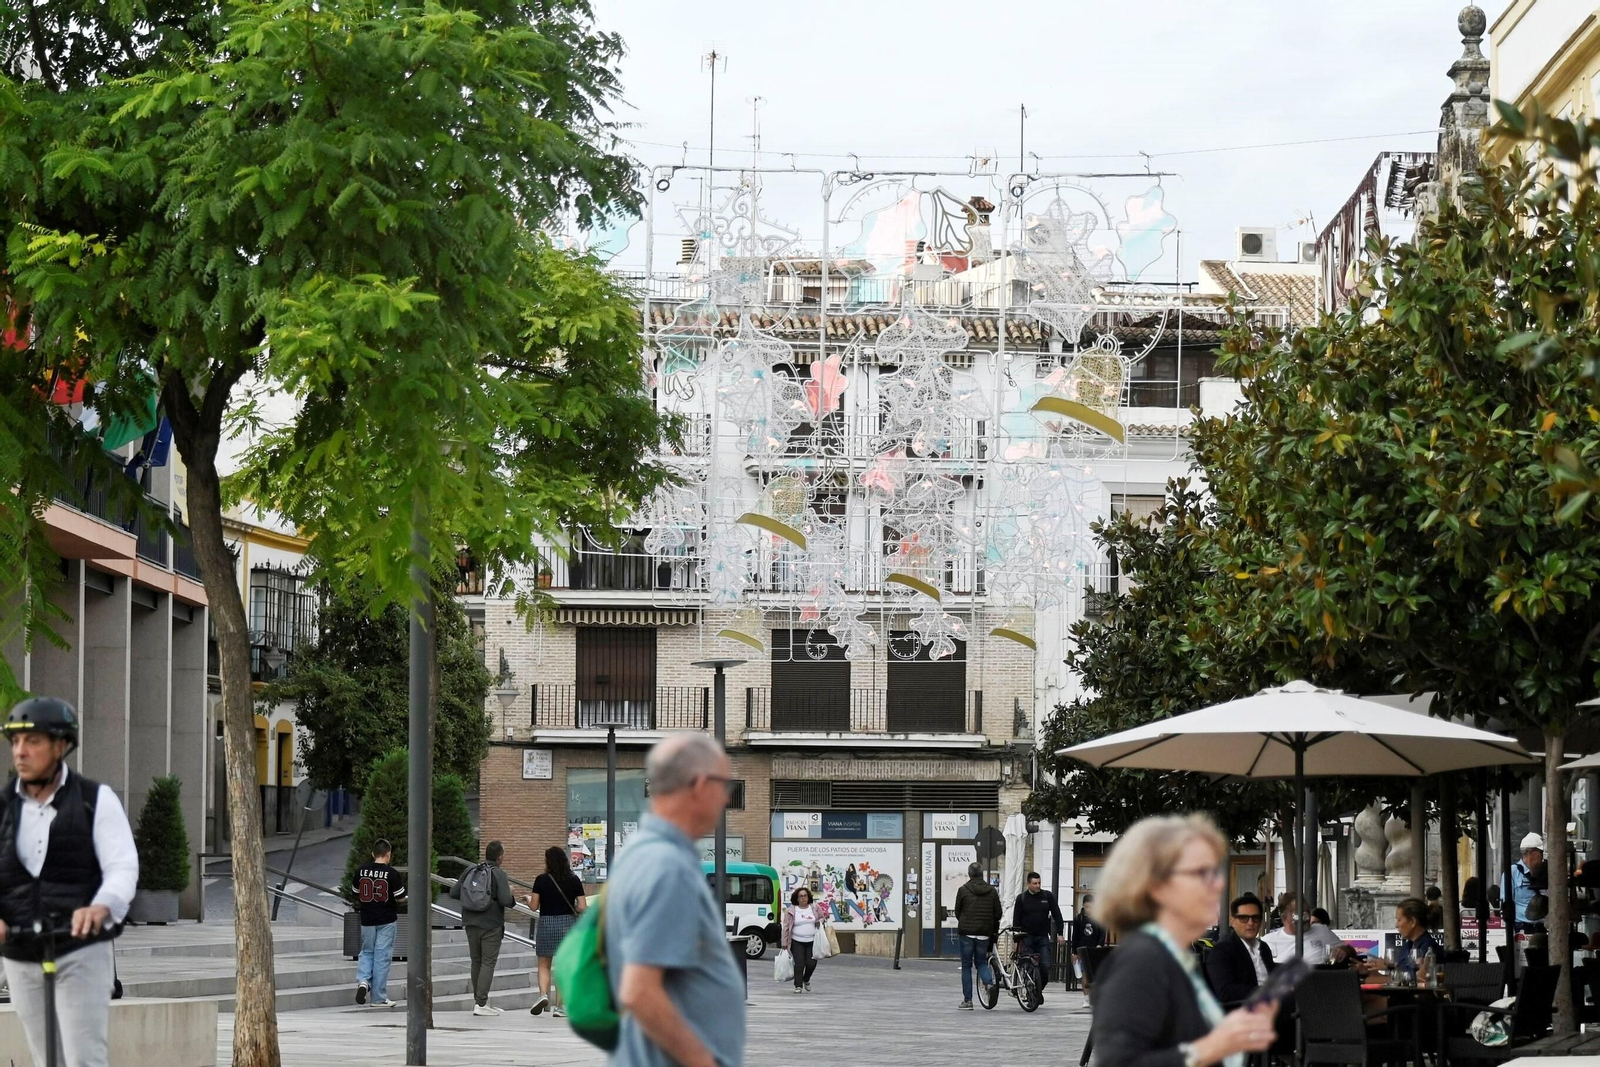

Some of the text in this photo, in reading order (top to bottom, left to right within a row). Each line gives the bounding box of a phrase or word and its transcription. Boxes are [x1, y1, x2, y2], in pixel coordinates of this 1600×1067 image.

[360, 869, 389, 879] LEAGUE
[925, 876, 932, 886] DE
[360, 877, 388, 902] 03
